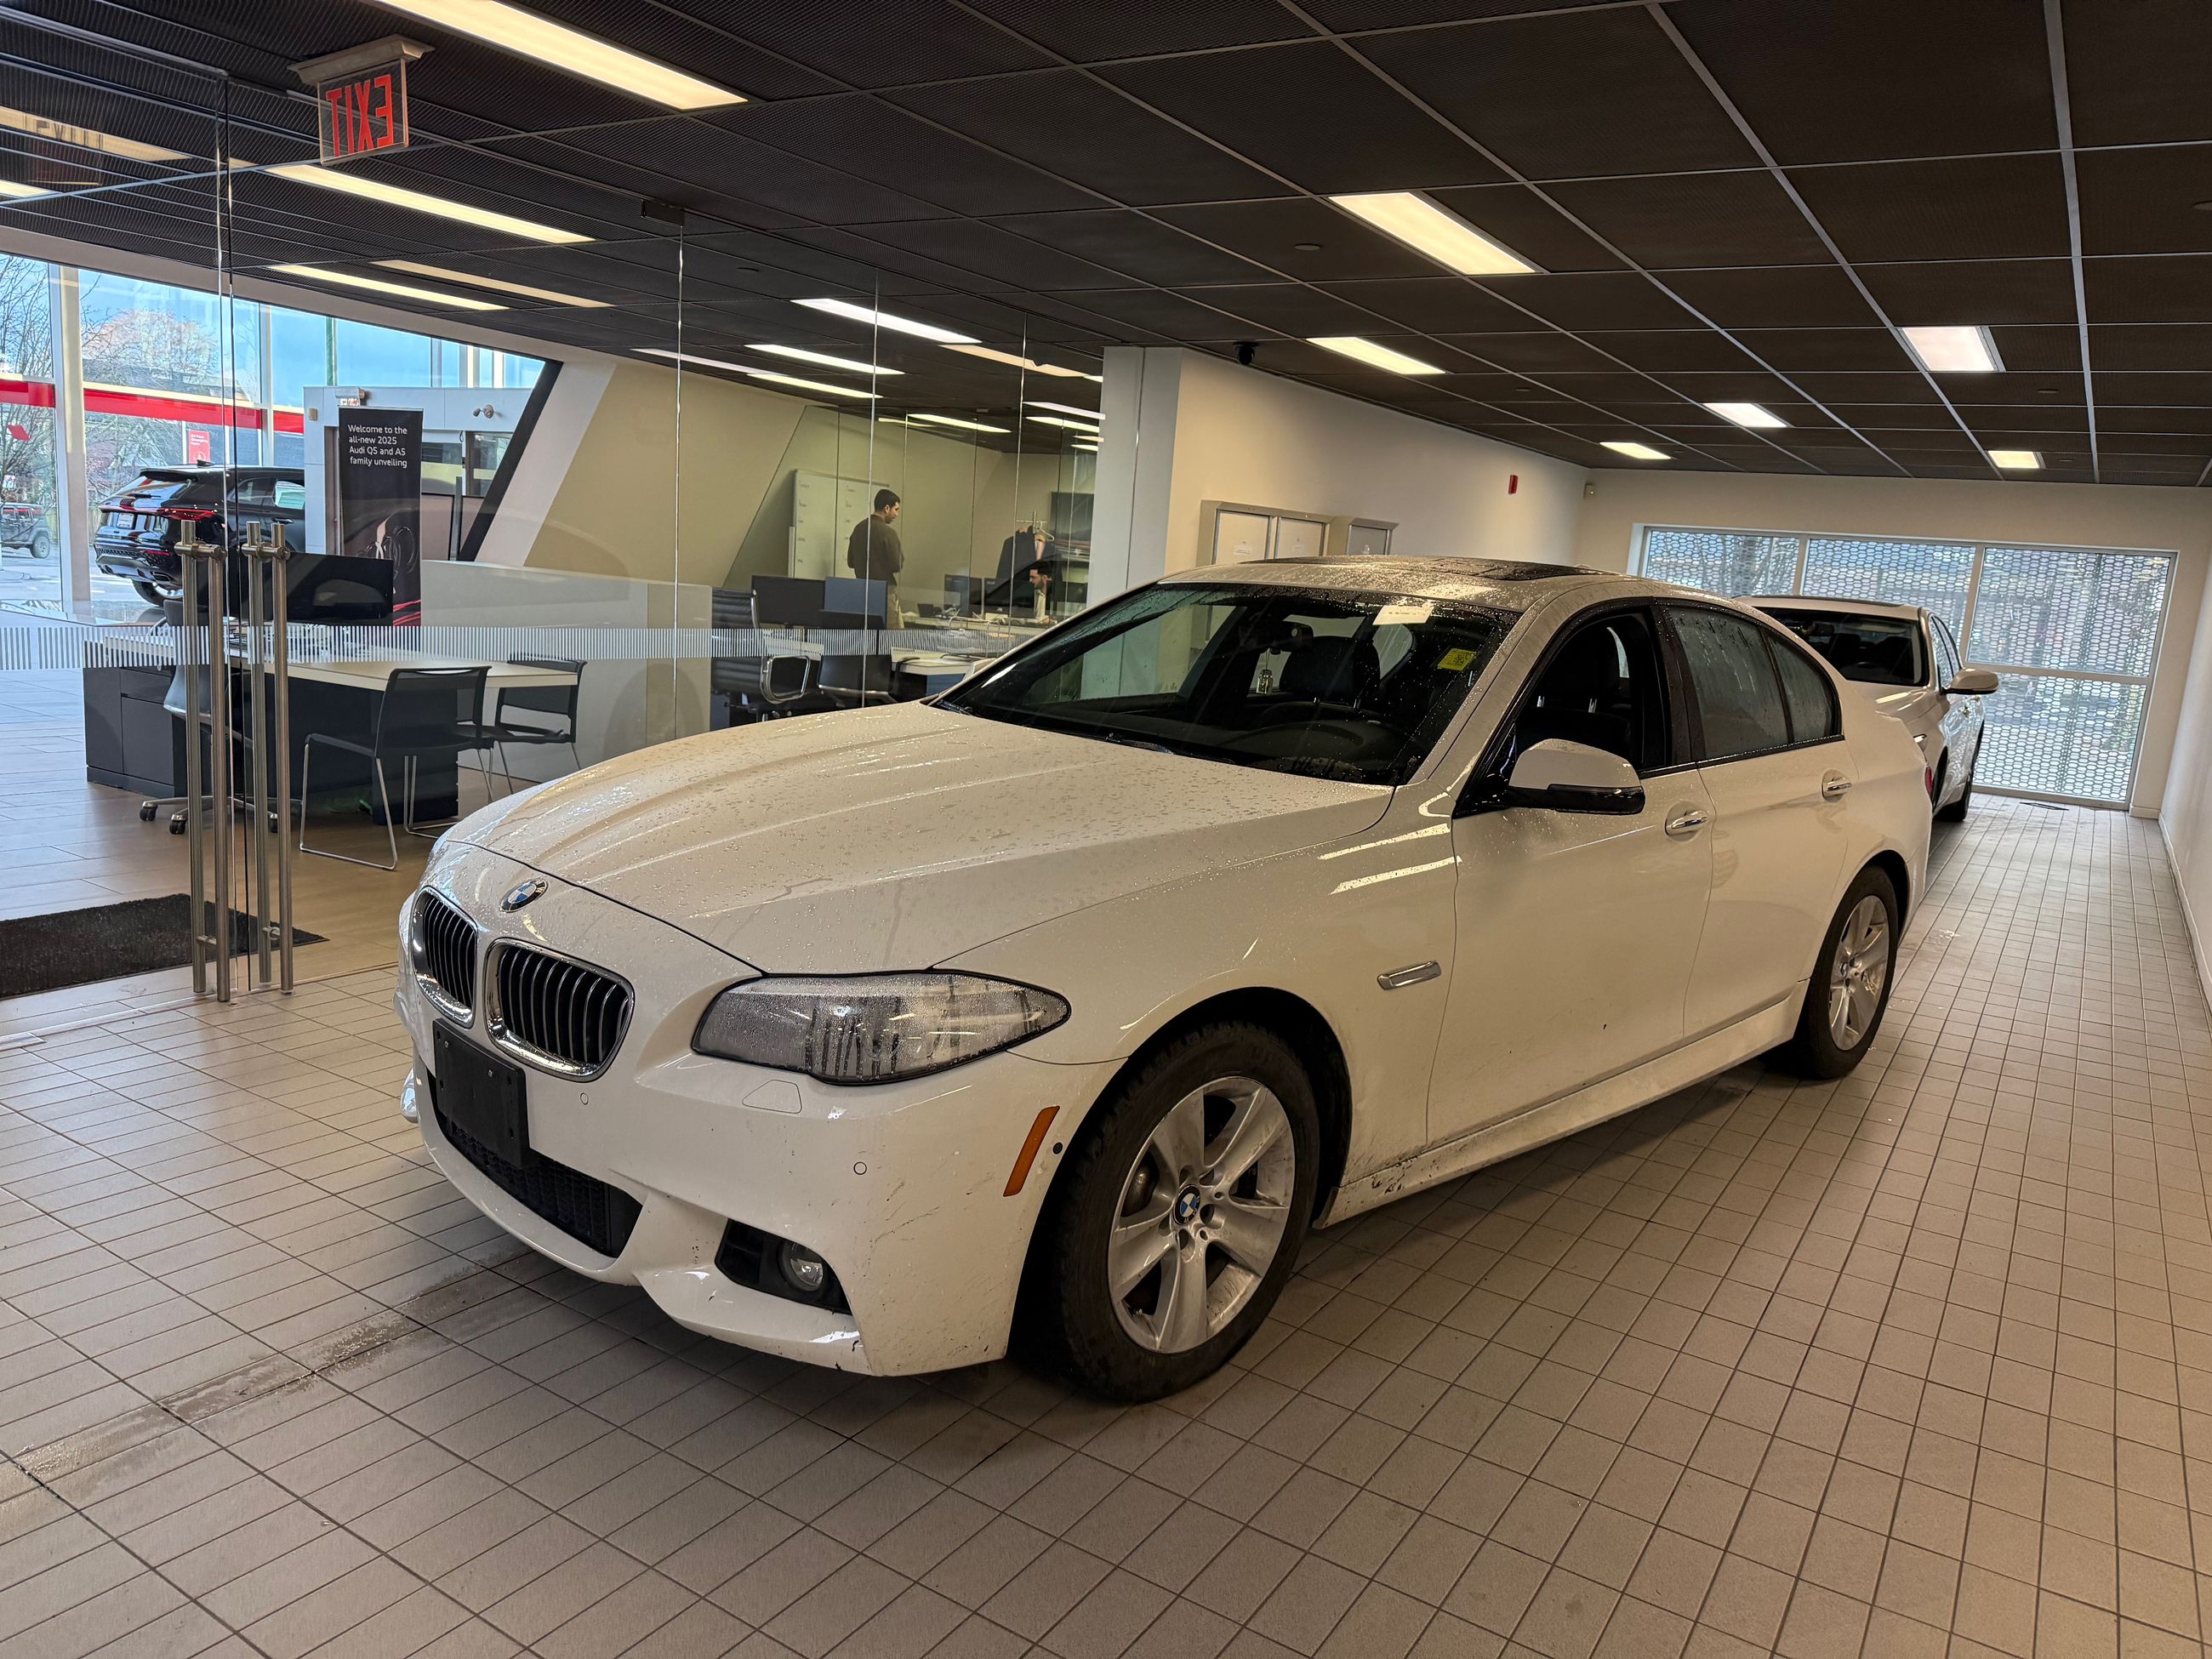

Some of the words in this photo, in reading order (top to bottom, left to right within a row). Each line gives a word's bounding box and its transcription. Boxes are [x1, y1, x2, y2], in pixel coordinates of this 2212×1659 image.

[348, 425, 383, 433] Welcome
[349, 435, 376, 443] all-new
[378, 436, 397, 444] 2025
[367, 446, 378, 455] Q5
[379, 447, 394, 455] and
[395, 448, 406, 456] A5
[350, 456, 373, 467] family
[374, 458, 408, 469] unveiling
